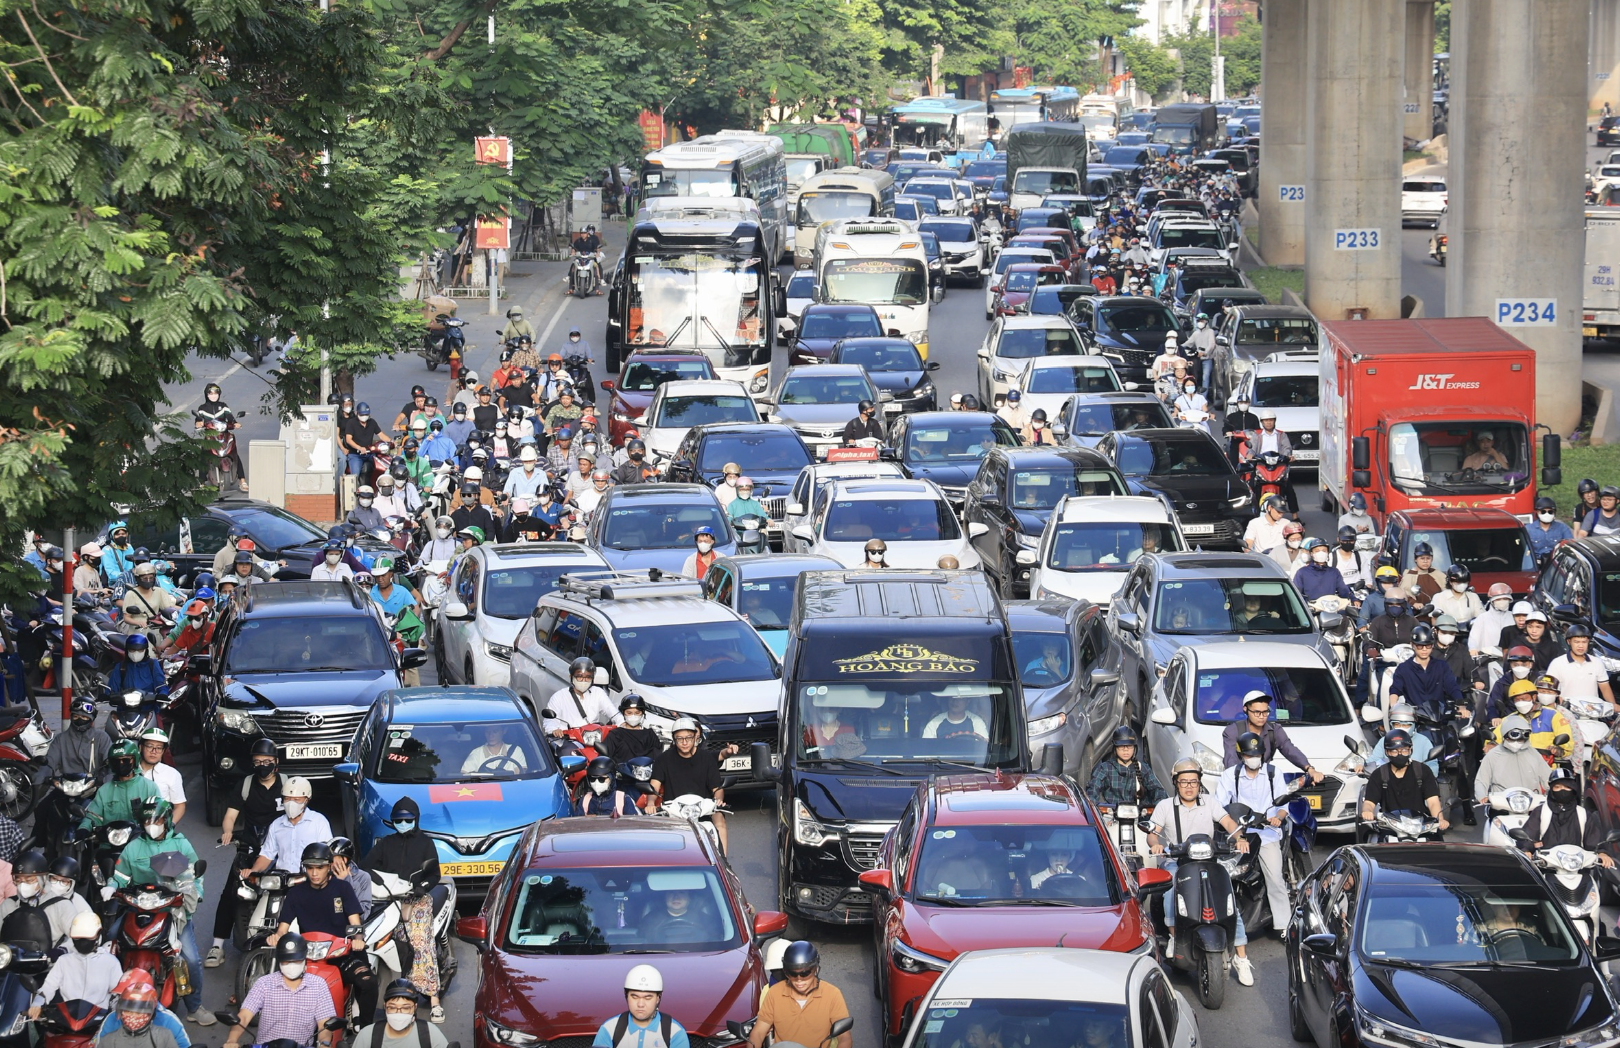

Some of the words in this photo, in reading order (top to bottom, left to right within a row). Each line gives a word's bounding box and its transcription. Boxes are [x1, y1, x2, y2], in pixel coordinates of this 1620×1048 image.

[1280, 187, 1304, 200] P23
[1336, 230, 1378, 248] P233
[1498, 302, 1556, 323] P234
[1408, 374, 1455, 390] J&T
[387, 753, 409, 763] TAXI
[444, 864, 501, 875] 29E-330.56
